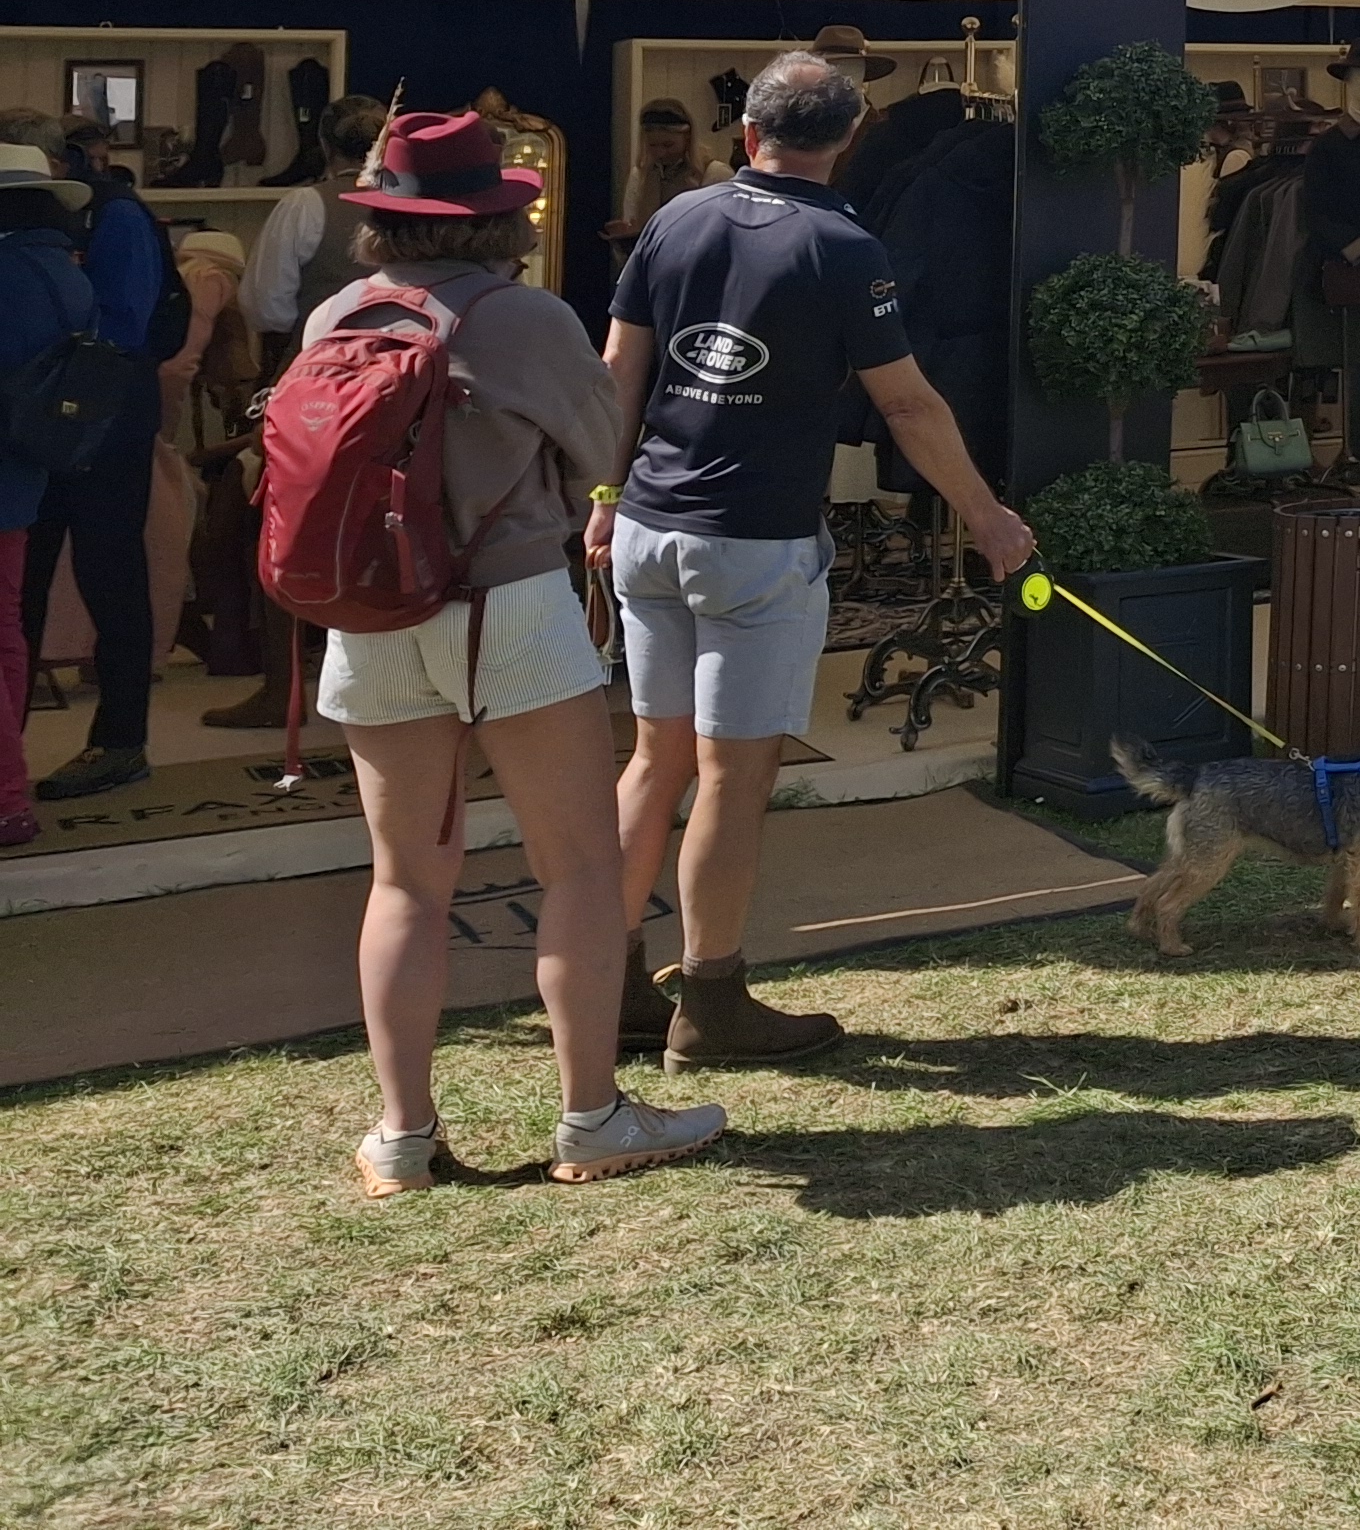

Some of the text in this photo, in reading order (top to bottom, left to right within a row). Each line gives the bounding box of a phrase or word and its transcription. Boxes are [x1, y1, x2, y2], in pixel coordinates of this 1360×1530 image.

[694, 333, 733, 353] LAND
[696, 349, 747, 371] ROVER
[665, 384, 702, 399] ABOVE
[711, 393, 763, 405] BEYOND
